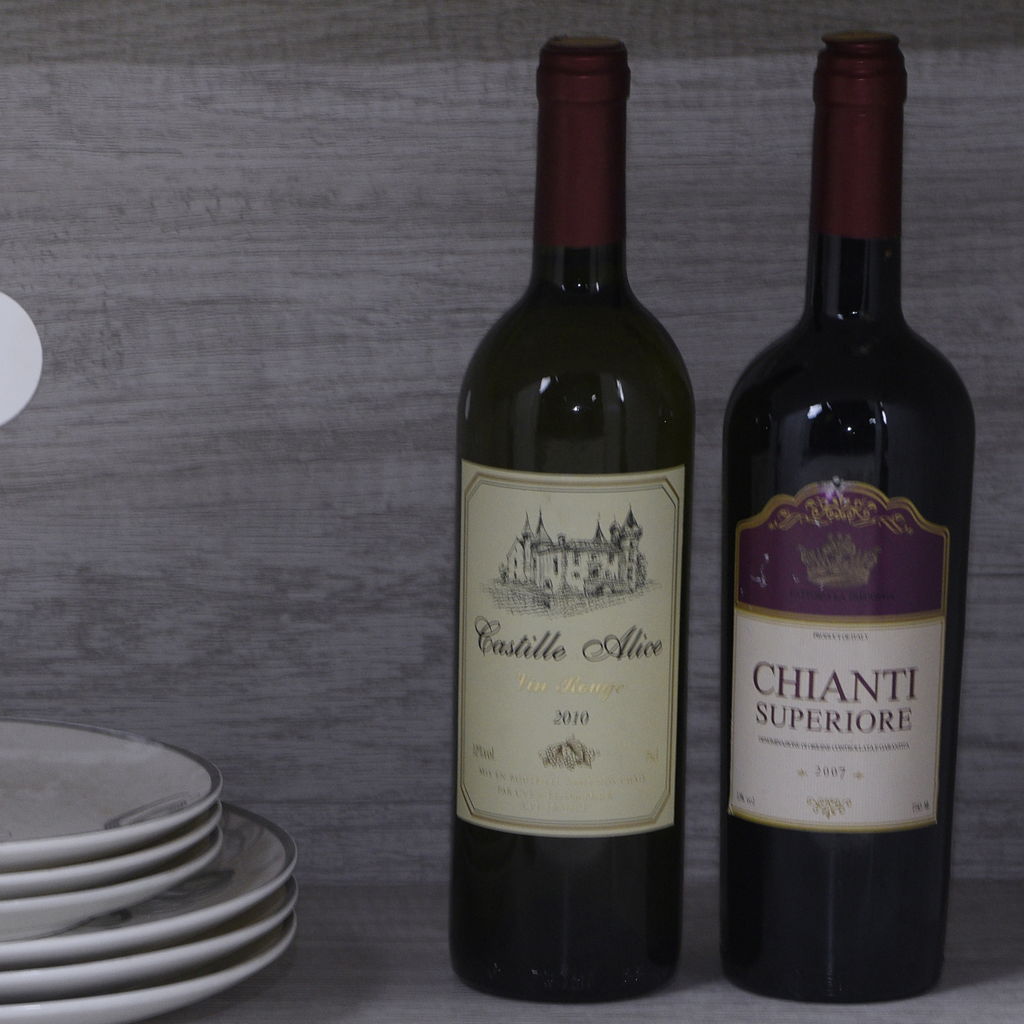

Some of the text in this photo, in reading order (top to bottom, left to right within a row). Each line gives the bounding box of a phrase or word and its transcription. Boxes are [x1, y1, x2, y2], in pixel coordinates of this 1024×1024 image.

[474, 616, 663, 662] Castille Alice
[753, 661, 918, 703] CHIANTI
[553, 710, 590, 726] 2010
[756, 701, 912, 733] SUPERIORE
[814, 764, 847, 781] 2007
